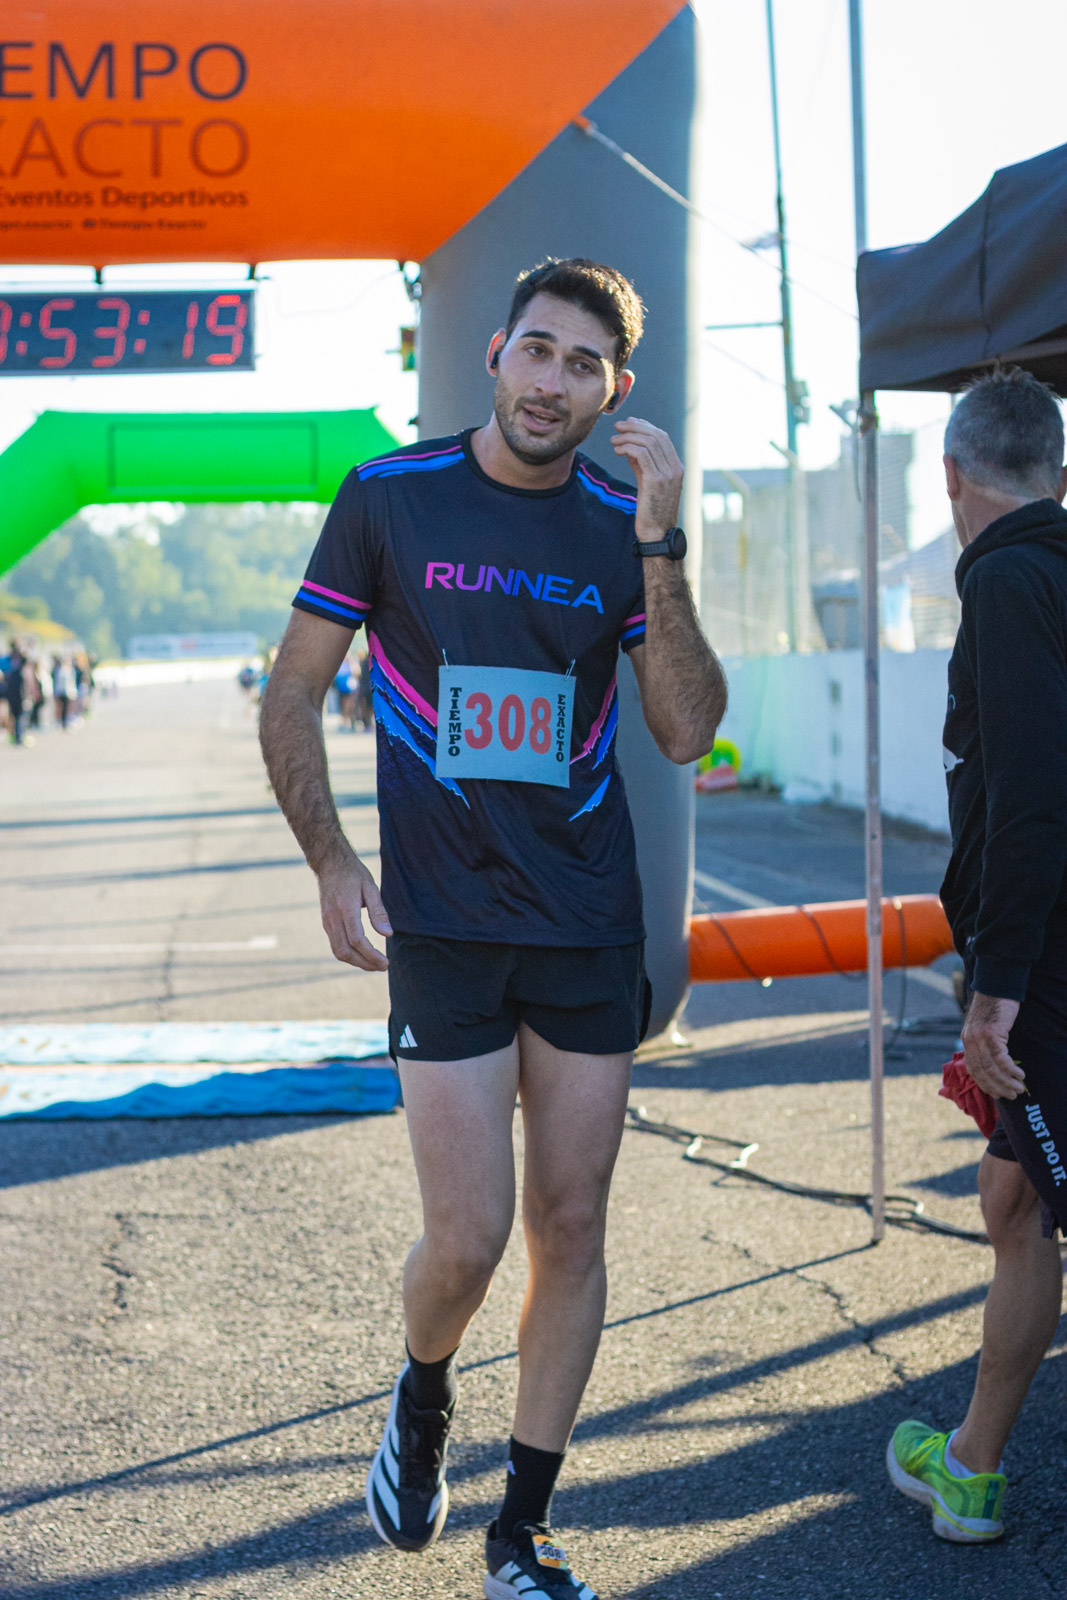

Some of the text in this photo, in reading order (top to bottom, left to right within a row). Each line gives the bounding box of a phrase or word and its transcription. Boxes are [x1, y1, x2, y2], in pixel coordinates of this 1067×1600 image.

[0, 117, 249, 179] ACTO
[101, 186, 248, 210] Deportivos
[425, 562, 604, 614] RUNNEA
[448, 687, 462, 757] TIEMPO
[464, 692, 552, 754] 308
[556, 694, 566, 762] EXACTO
[1025, 1104, 1067, 1186] JUST DO IT.
